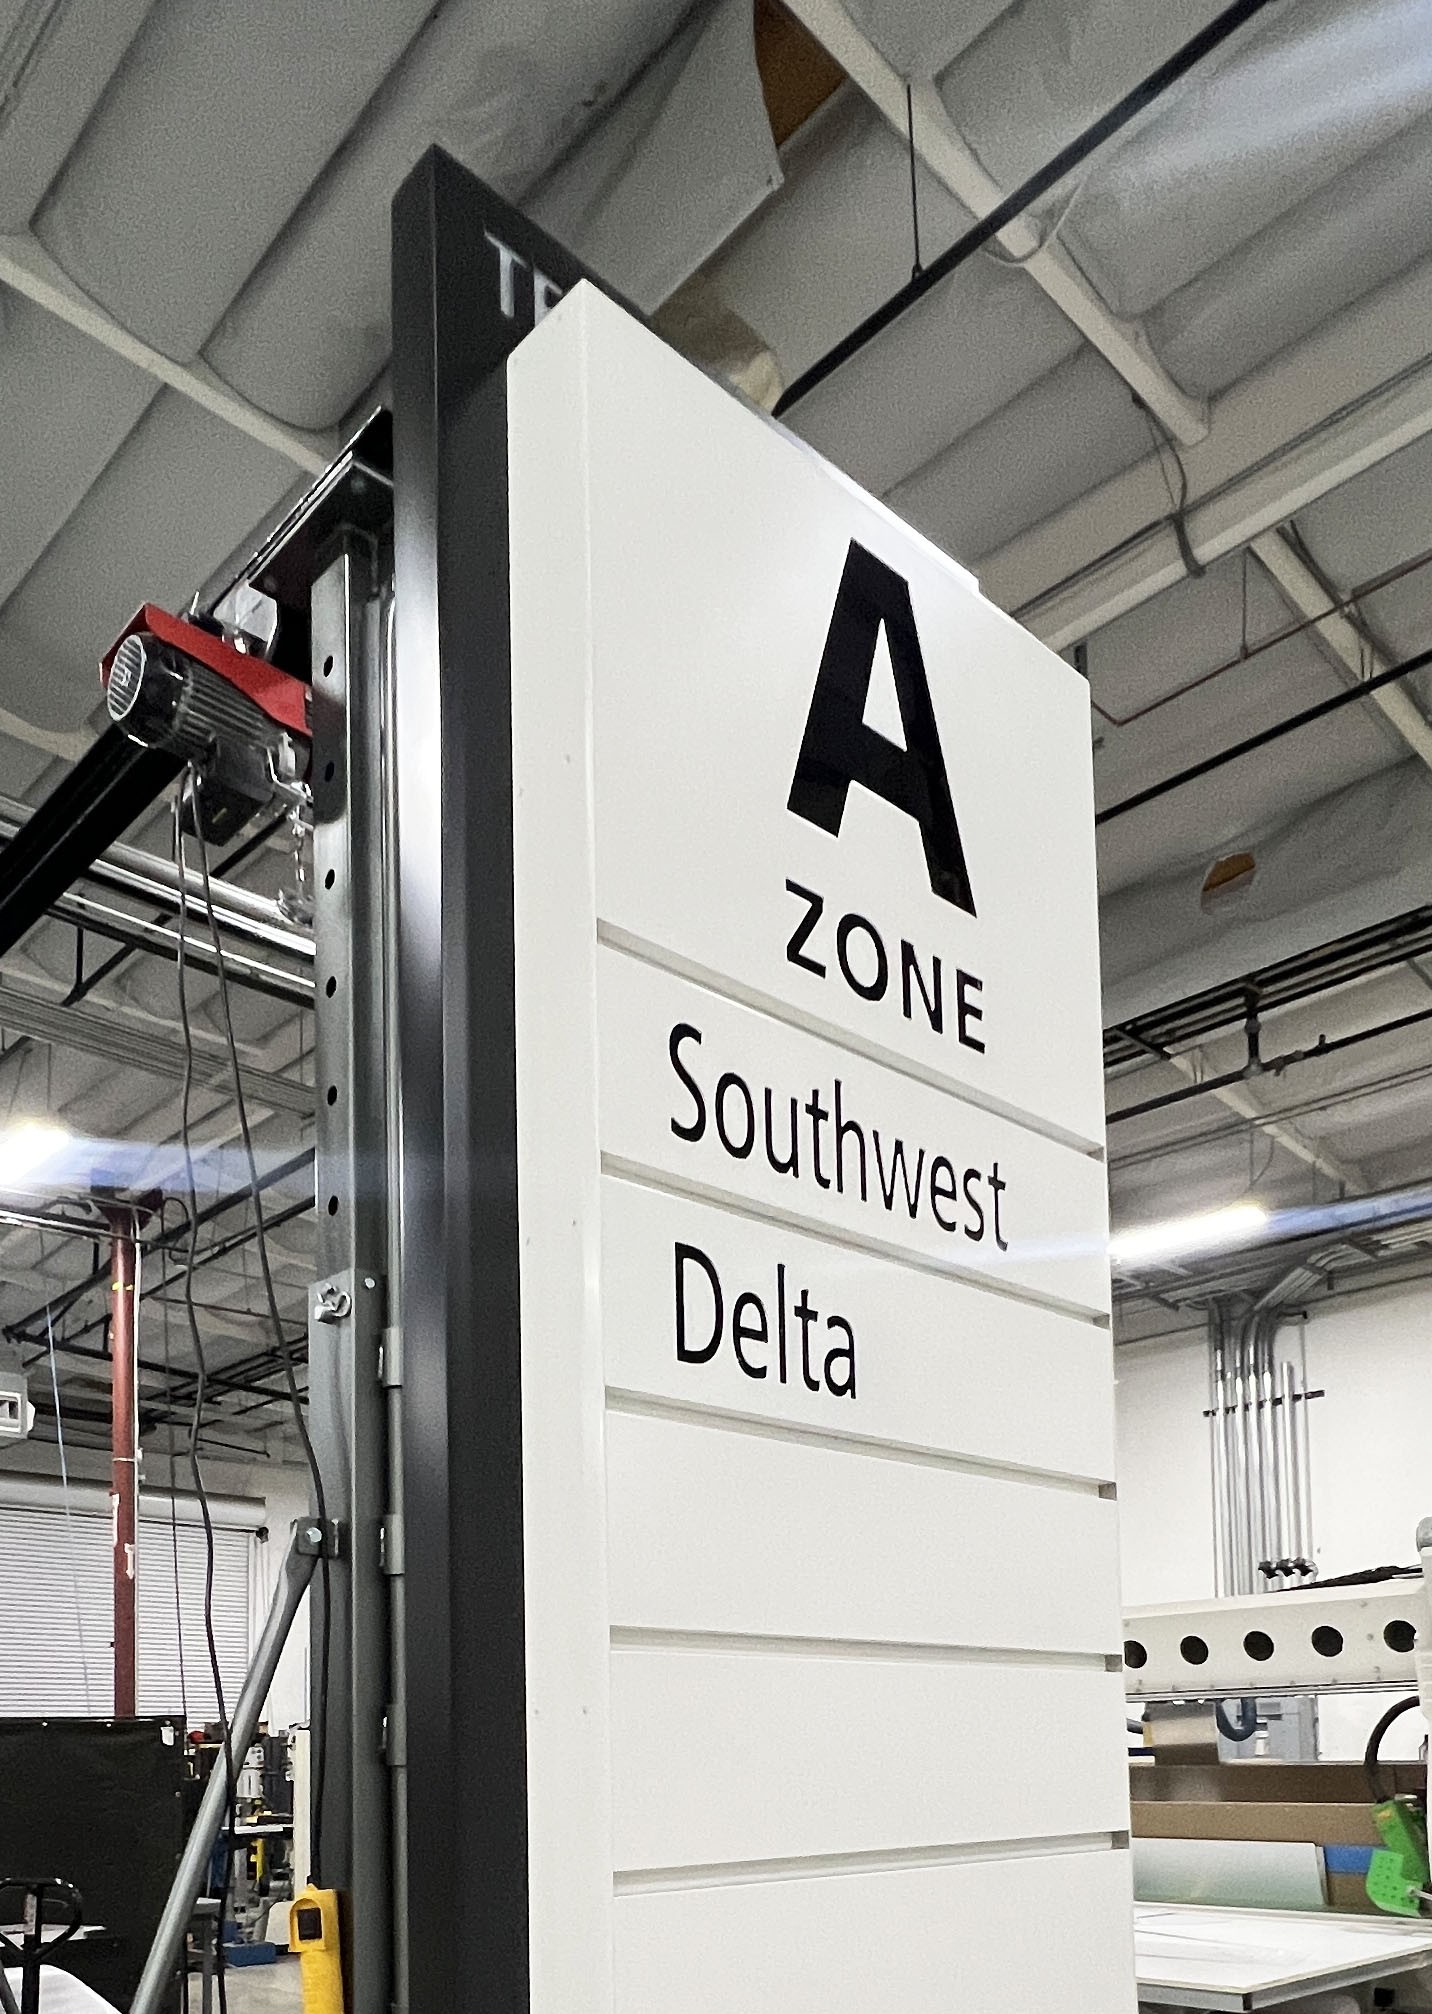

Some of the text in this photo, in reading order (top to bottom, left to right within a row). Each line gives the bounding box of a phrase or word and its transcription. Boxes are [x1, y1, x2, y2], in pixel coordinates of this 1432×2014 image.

[787, 539, 976, 917] A
[785, 878, 986, 1055] ZONE
[670, 1023, 1008, 1251] Southwest
[674, 1241, 857, 1400] Delta
